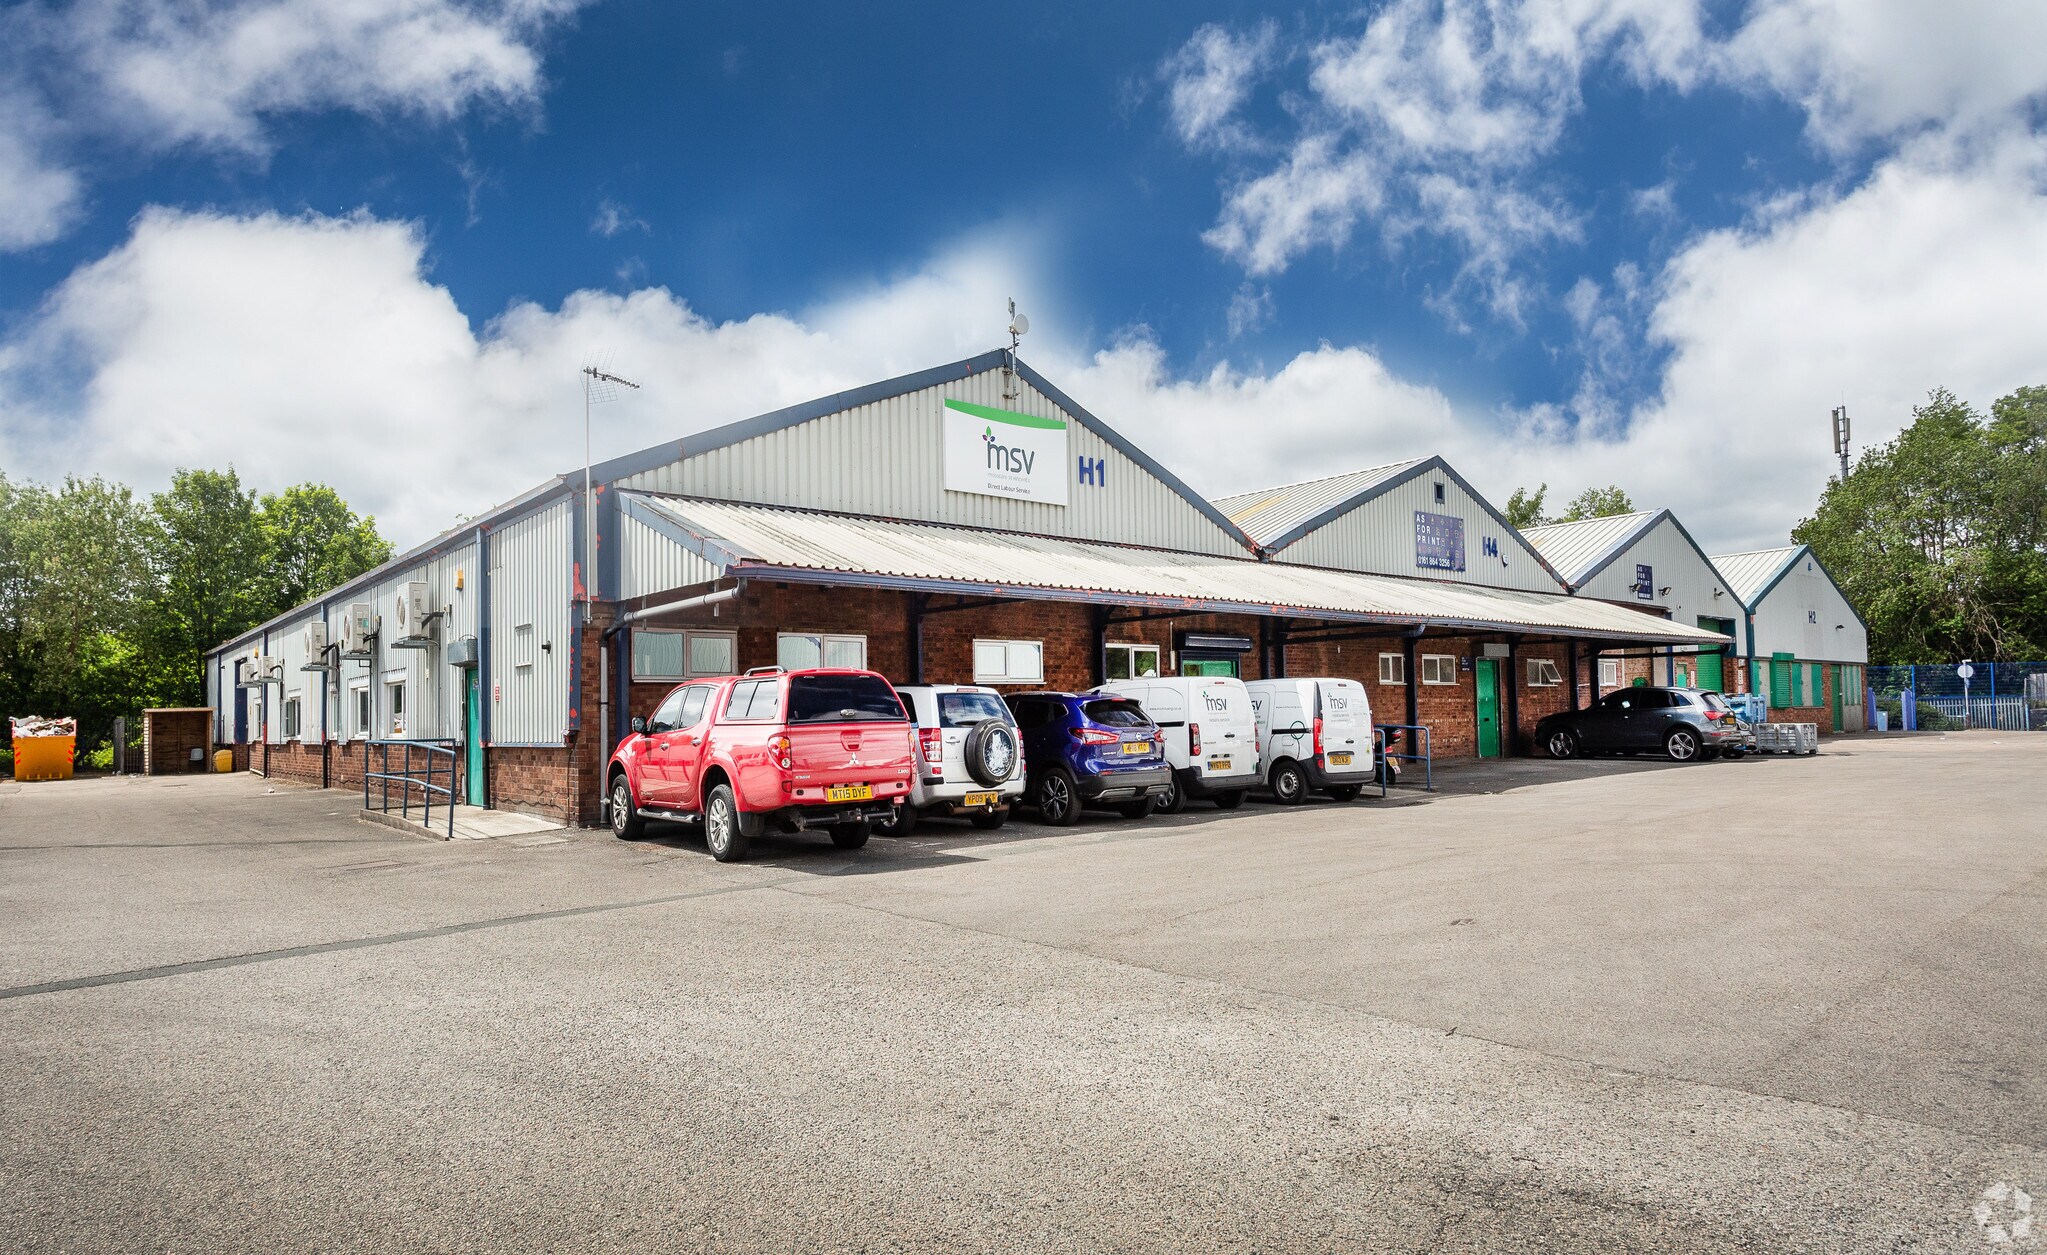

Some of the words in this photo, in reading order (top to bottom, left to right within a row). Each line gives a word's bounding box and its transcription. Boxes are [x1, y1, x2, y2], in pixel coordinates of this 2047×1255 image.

[987, 441, 1035, 475] msv
[1079, 456, 1104, 487] H1
[1416, 514, 1425, 523] AS
[1417, 525, 1431, 534] FOR
[1418, 535, 1440, 546] PRINT
[1483, 536, 1498, 557] H4
[1808, 611, 1817, 624] H2
[1206, 698, 1227, 711] msv
[1330, 698, 1348, 709] msv
[832, 788, 850, 799] MT15
[852, 787, 867, 798] DYF
